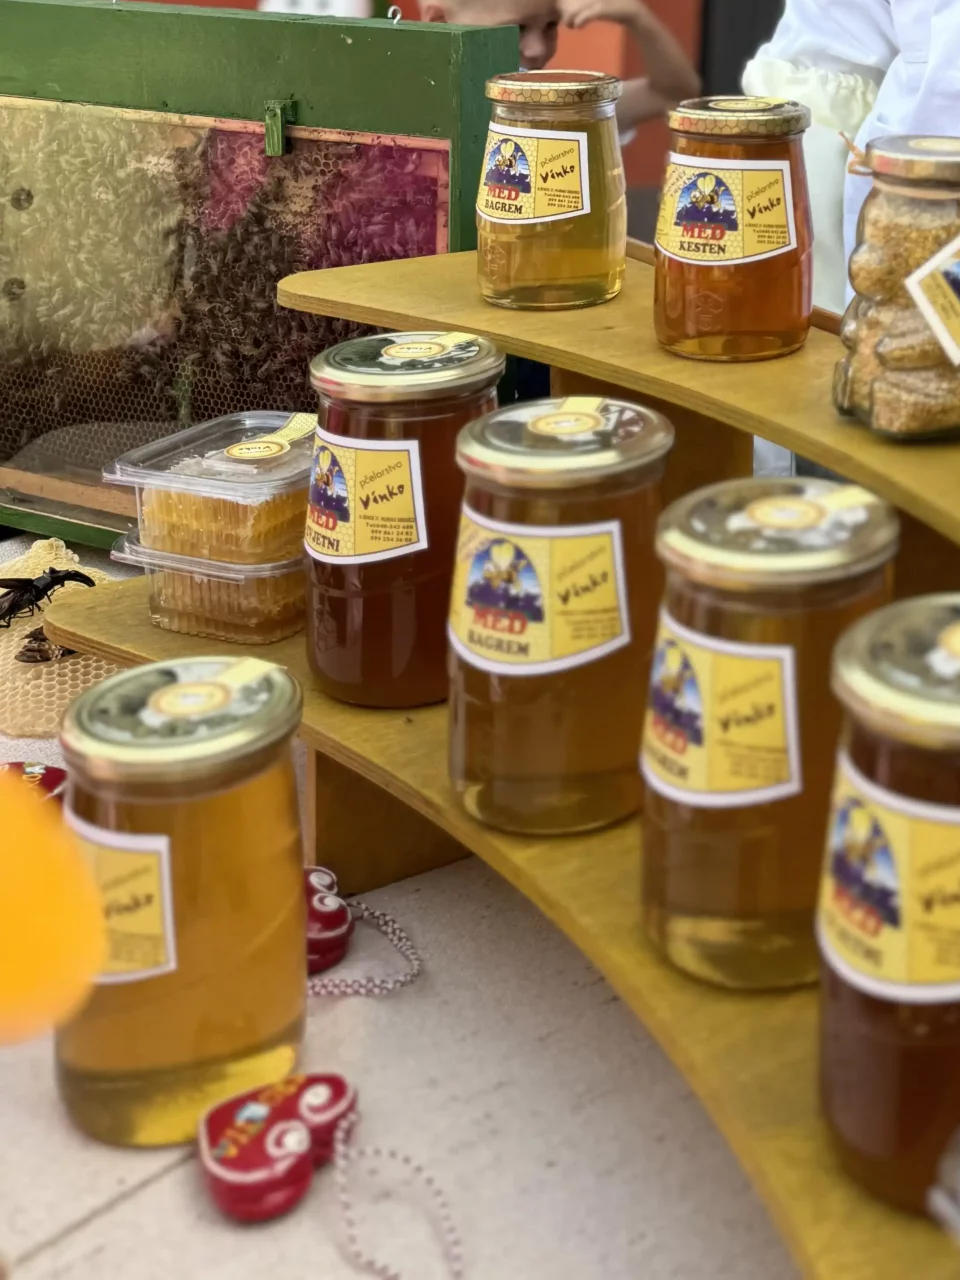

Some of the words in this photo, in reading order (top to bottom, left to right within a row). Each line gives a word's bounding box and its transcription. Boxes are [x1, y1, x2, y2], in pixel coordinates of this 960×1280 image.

[540, 147, 575, 168] pčelarstvo
[539, 164, 576, 184] Vinko
[487, 184, 520, 202] MED
[485, 199, 524, 215] BAGREM
[746, 197, 782, 220] Vinko
[681, 221, 726, 242] MED
[679, 240, 727, 255] KESTEN
[359, 460, 403, 489] pčelarstvo
[359, 484, 405, 510] Vinko
[556, 571, 609, 606] Vinko
[471, 604, 529, 635] MED
[467, 629, 531, 658] BAGREM
